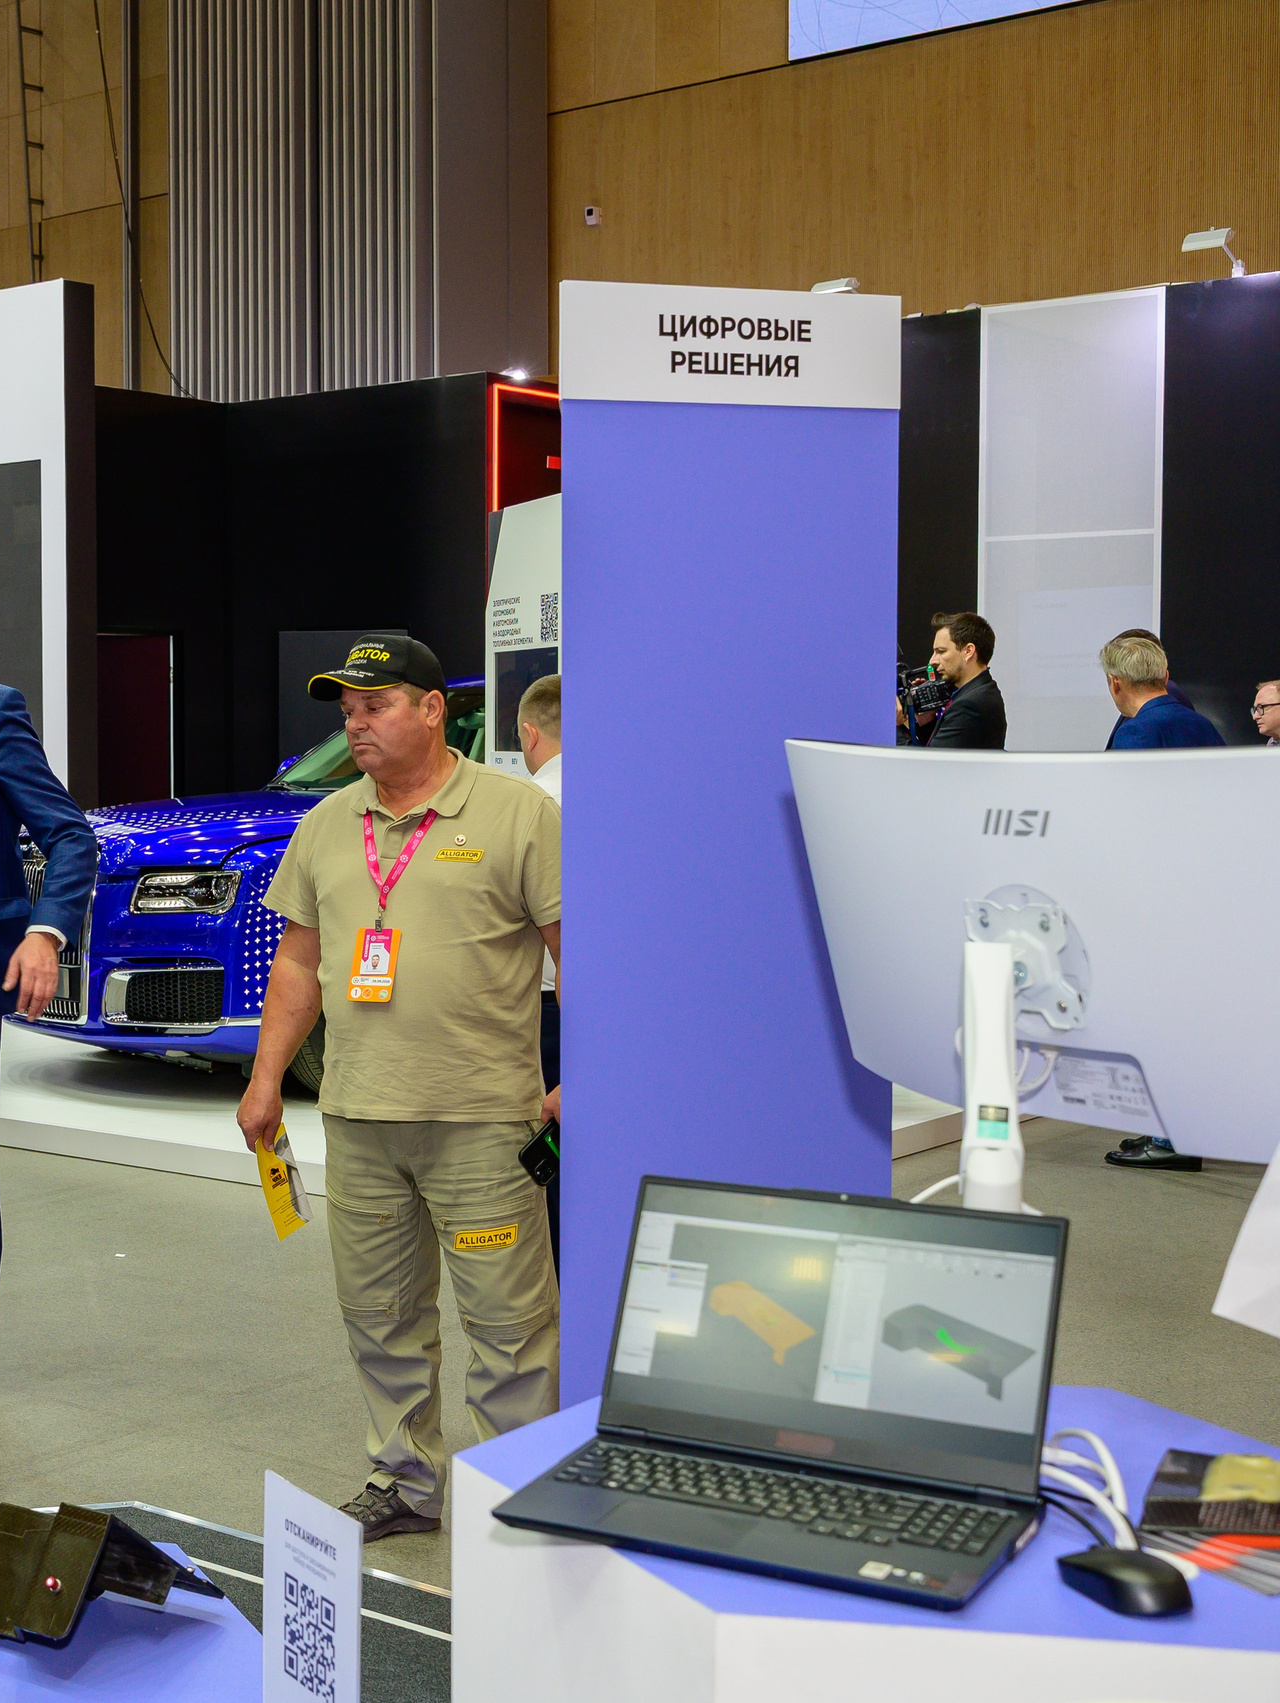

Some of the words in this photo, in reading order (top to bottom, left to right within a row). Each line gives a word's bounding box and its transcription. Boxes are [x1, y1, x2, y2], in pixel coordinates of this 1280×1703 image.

[658, 313, 812, 343] ЦИФРОВЫЕ
[670, 350, 800, 378] РЕШЕНИЯ
[982, 808, 1050, 837] MSI
[439, 850, 479, 859] ALLIGATOR
[458, 1231, 513, 1245] ALLIGATOR
[284, 1518, 337, 1561] ОТСКАНИРУЙТЕ
